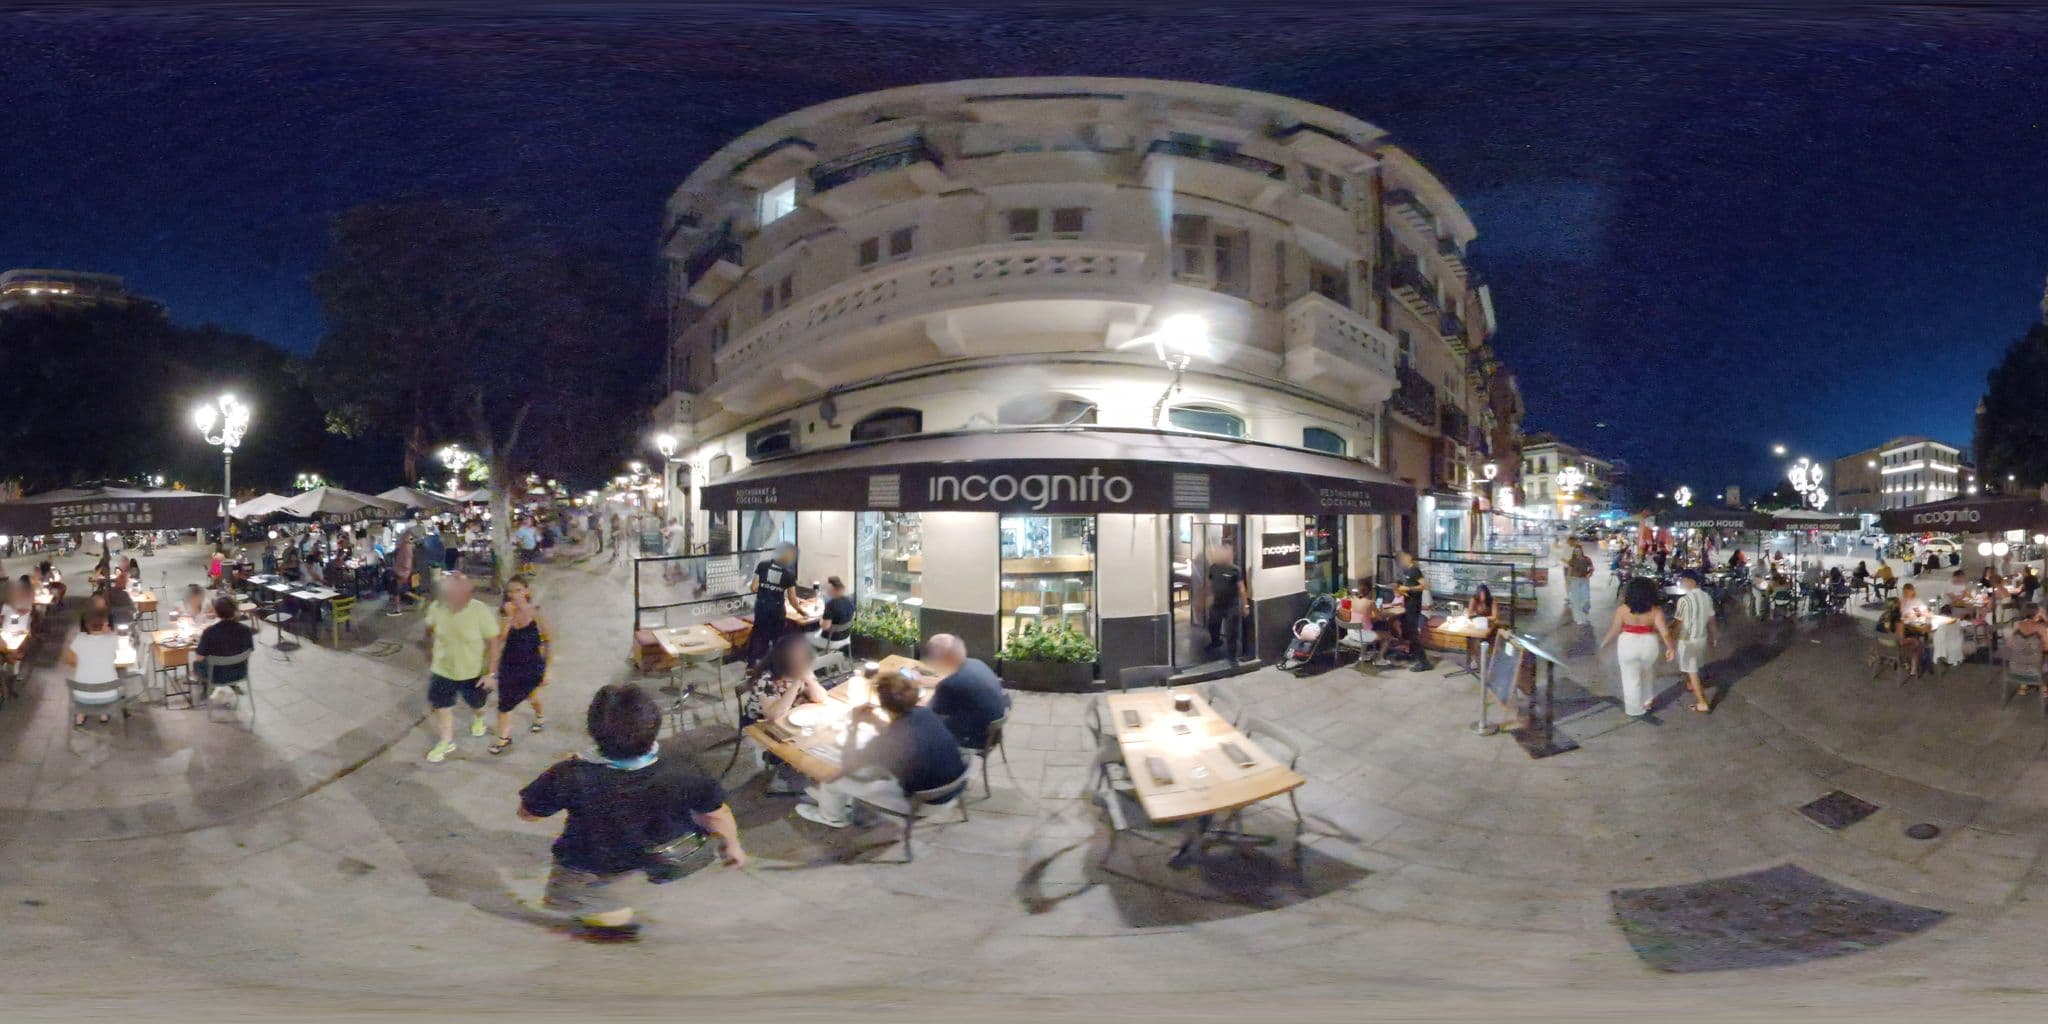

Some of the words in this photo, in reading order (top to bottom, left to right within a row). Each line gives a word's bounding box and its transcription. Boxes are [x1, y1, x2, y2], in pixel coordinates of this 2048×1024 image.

[929, 467, 1133, 510] incognito
[51, 503, 136, 516] RESTAURANT
[1913, 507, 1980, 525] incognito
[51, 515, 120, 527] COCKTAIL
[127, 513, 152, 524] BAR
[1690, 520, 1714, 528] KOKO
[1716, 520, 1744, 528] HOUSE
[1262, 543, 1302, 555] incognito
